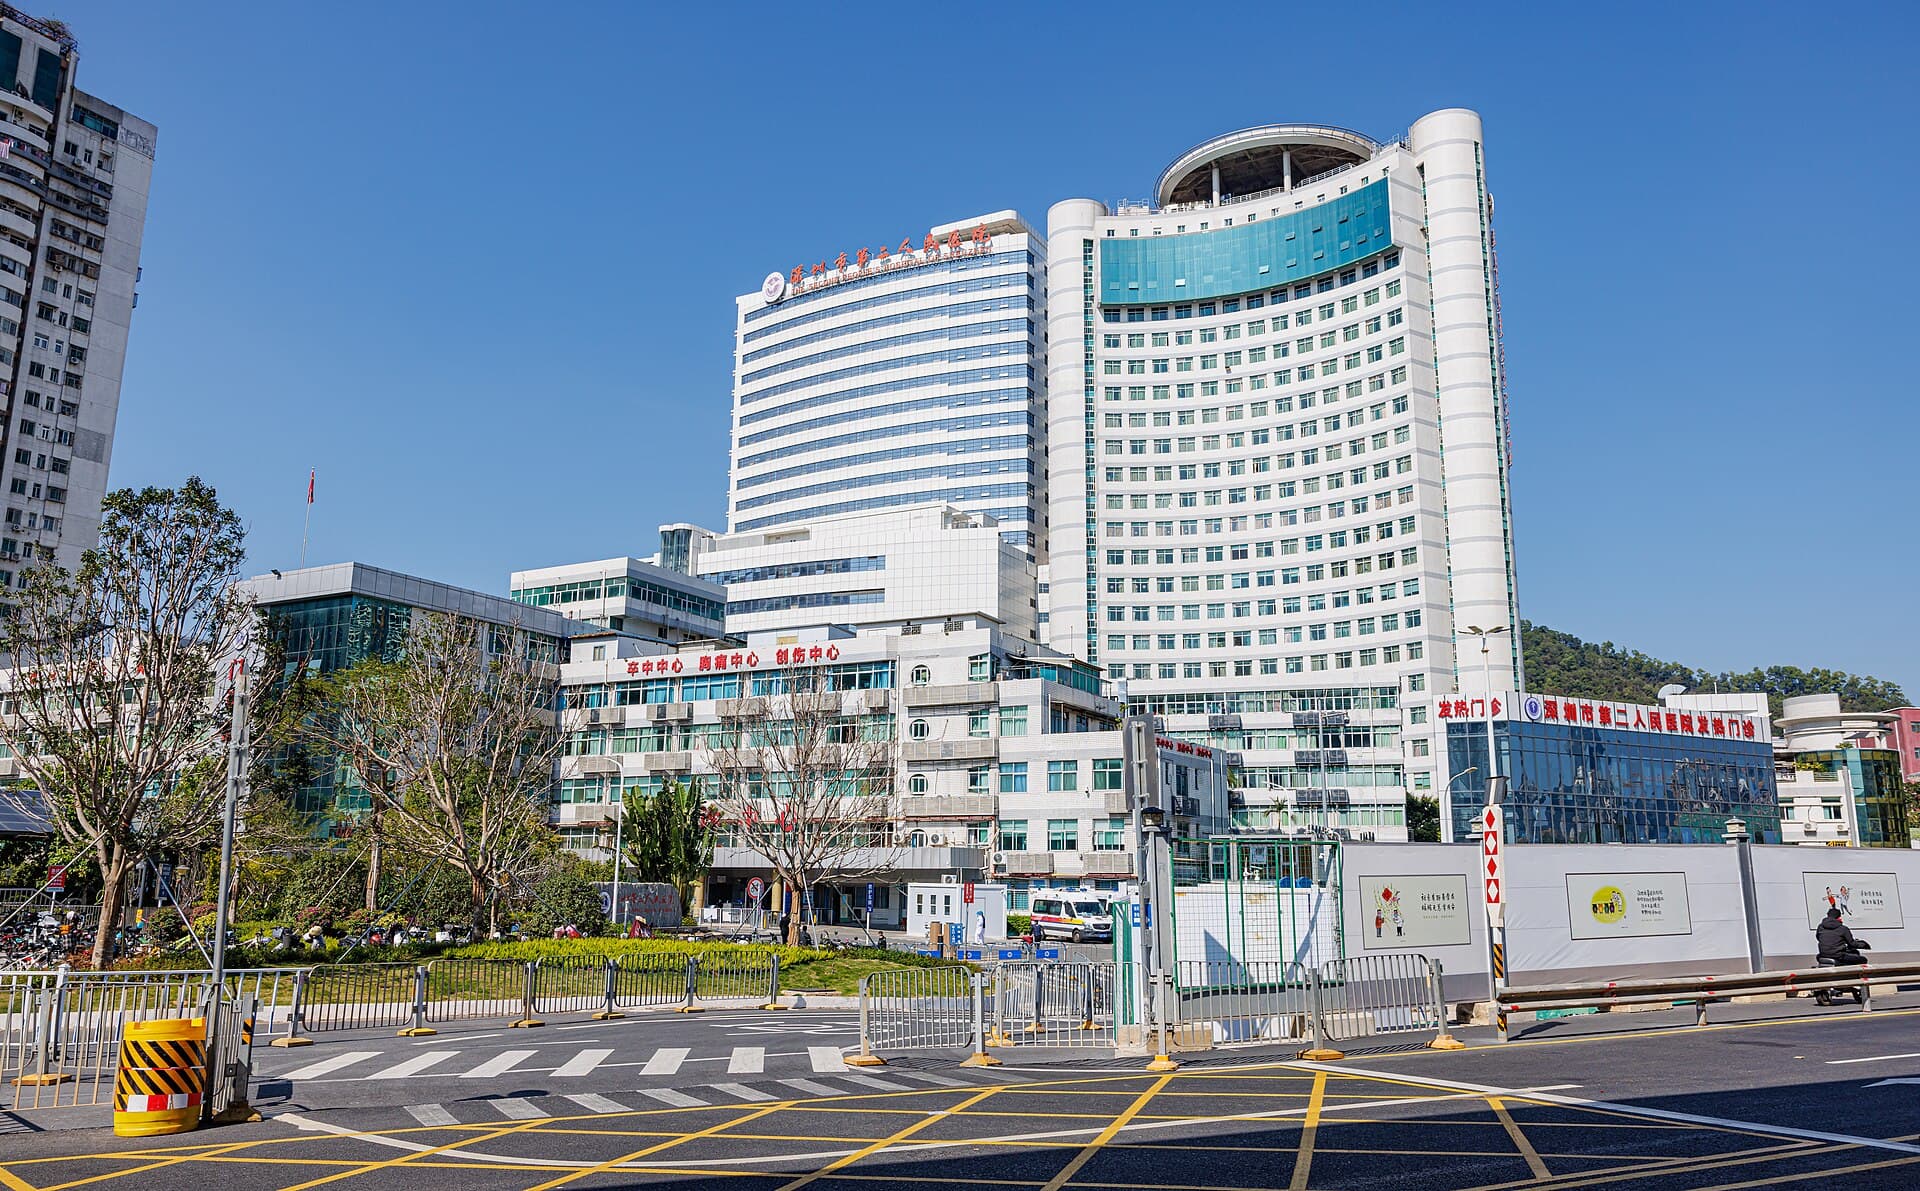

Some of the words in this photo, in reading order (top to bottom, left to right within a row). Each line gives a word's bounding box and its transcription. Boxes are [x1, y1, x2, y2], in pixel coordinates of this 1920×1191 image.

[790, 223, 991, 283] 深圳市第二人民医院
[627, 657, 683, 677] 卒中中心
[699, 651, 760, 671] 胸痛中心
[775, 643, 840, 665] 创伤中心
[1543, 699, 1755, 738] 深圳市第二人民医院发热门诊
